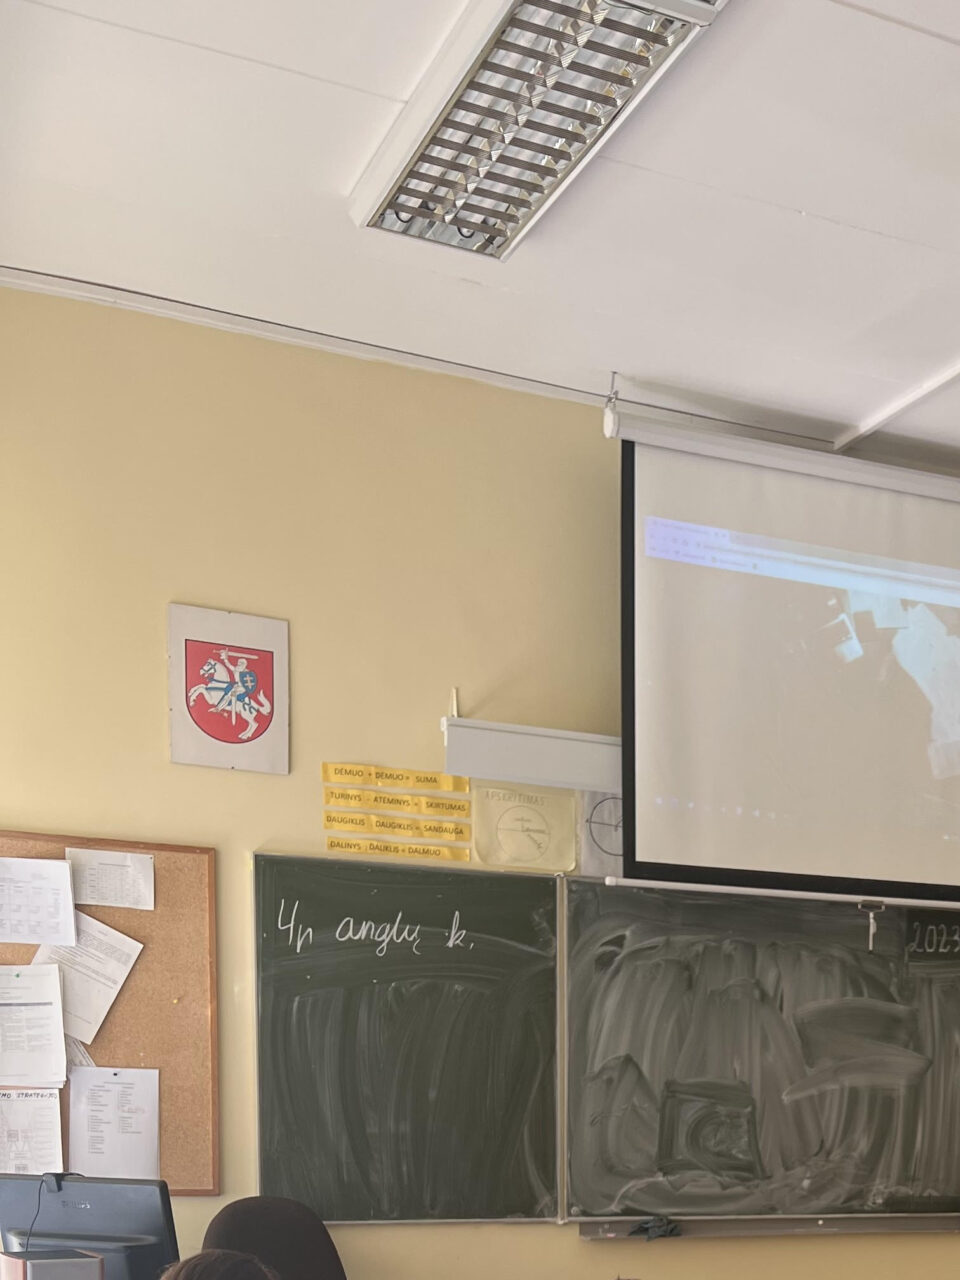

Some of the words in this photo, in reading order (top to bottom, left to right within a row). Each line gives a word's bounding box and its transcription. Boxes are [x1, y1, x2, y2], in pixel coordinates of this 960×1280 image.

[415, 775, 438, 785] SUMA
[329, 791, 362, 802] TURINYS
[423, 824, 464, 835] SANDAUGA
[330, 840, 362, 850] DALINYS
[408, 846, 441, 857] DALMUO
